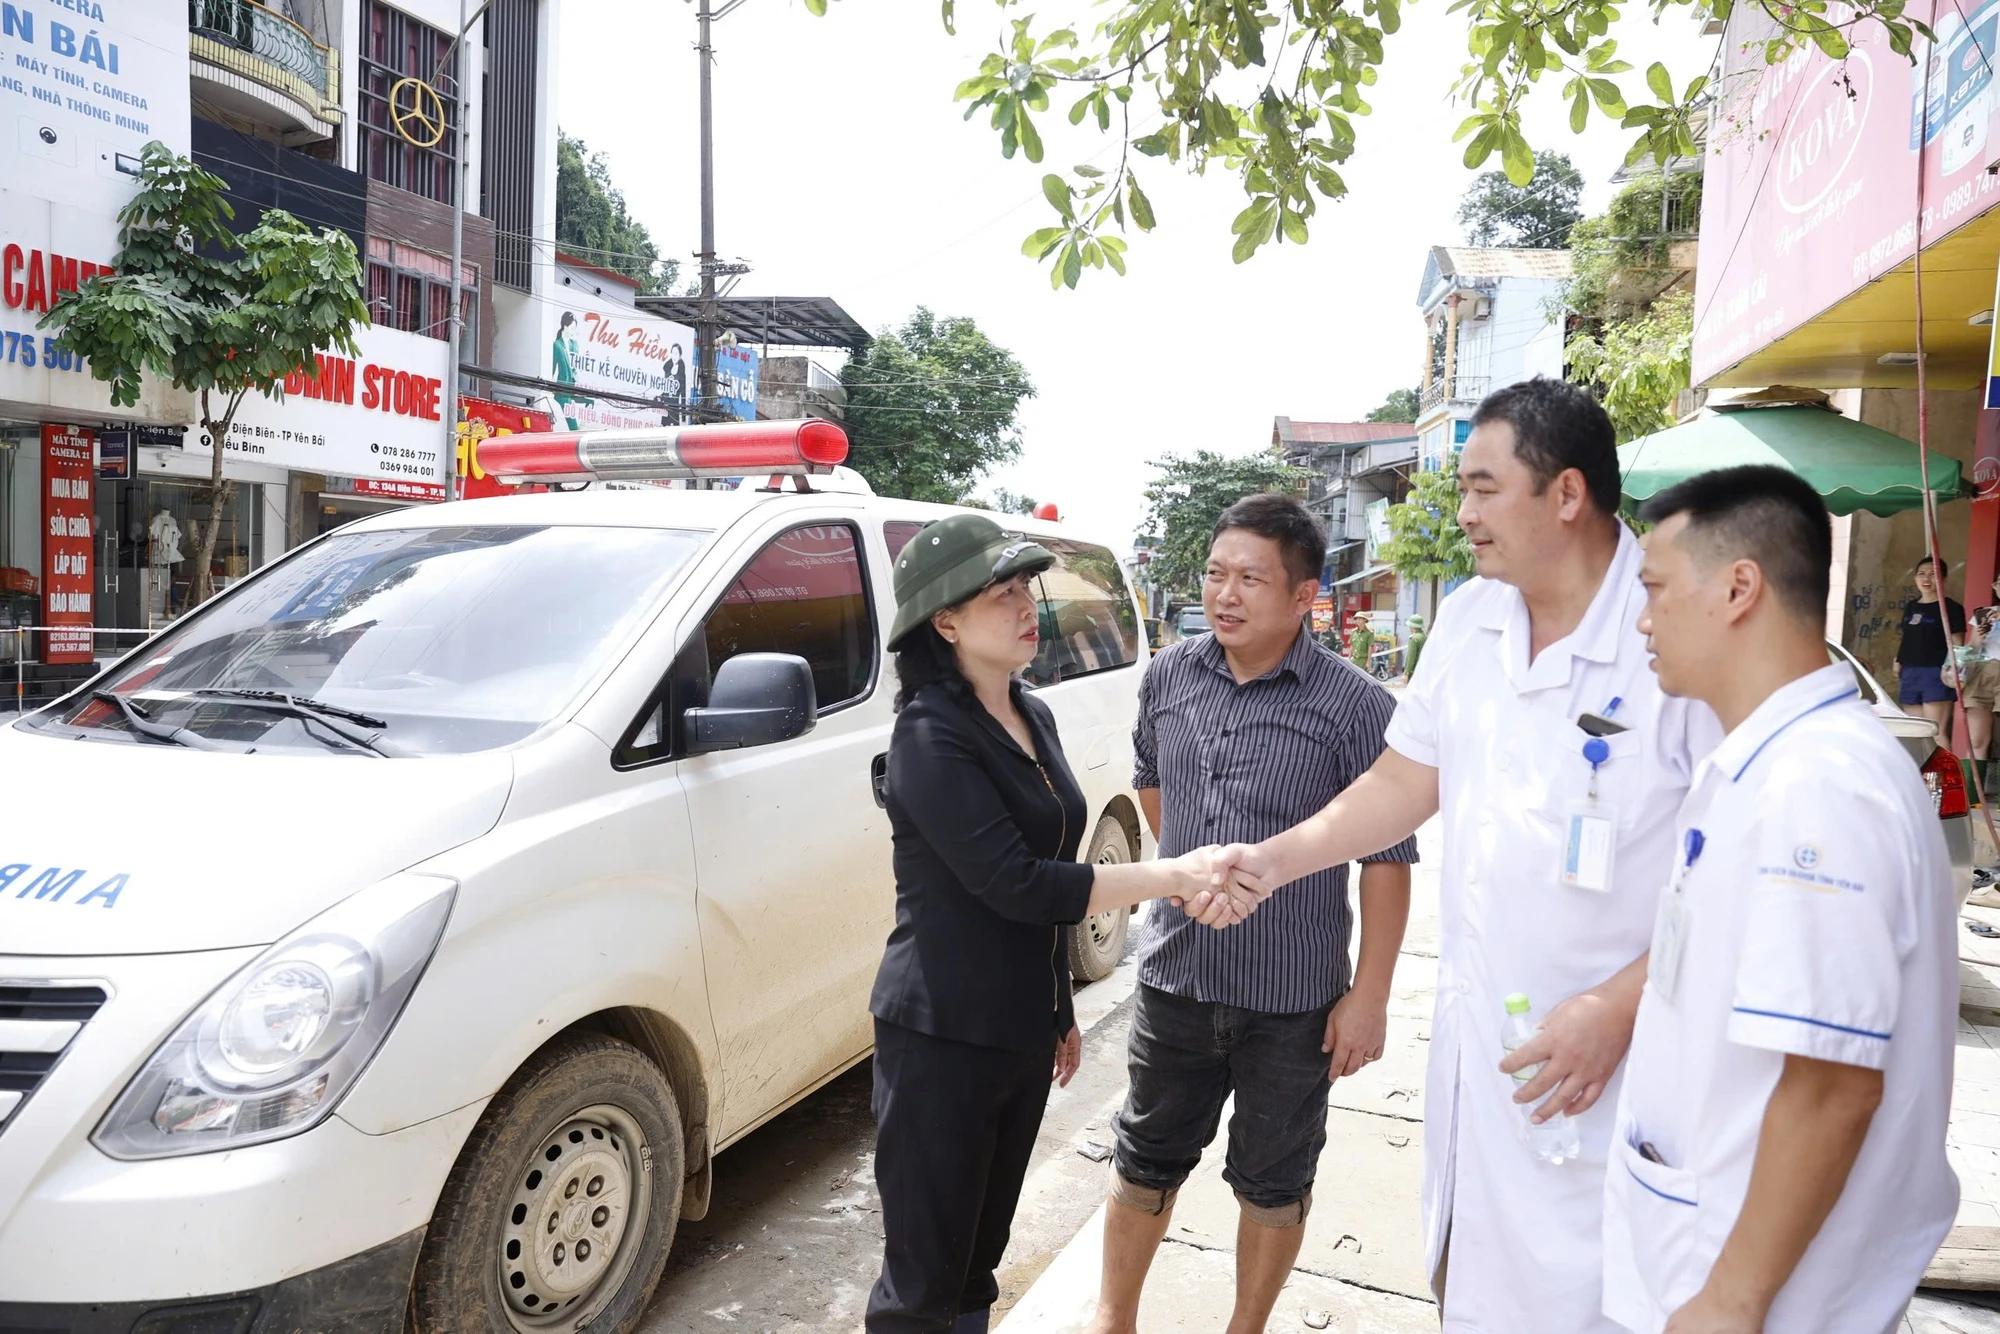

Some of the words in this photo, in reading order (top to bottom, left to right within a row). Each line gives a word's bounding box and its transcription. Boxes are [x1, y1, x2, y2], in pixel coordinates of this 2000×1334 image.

[51, 20, 118, 75] BÁI
[16, 54, 48, 75] MÁY
[53, 67, 89, 91] TÍNH,
[93, 82, 148, 110] CAMERA
[66, 97, 111, 123] THÔNG
[115, 114, 149, 135] MINH
[1788, 95, 1856, 185] KOVA
[1869, 206, 1933, 268] 0972.066.78
[3, 243, 115, 313] CAM
[0, 330, 36, 367] 75
[584, 312, 619, 348] Thu
[628, 327, 668, 362] Hiền
[569, 351, 595, 373] THIẾT
[598, 356, 611, 377] KẾ
[613, 365, 647, 385] CHUYÊN
[650, 376, 680, 397] NGHIỆP
[717, 369, 739, 399] SÀN
[362, 364, 441, 421] STORE
[52, 434, 68, 446] MÁY
[69, 435, 88, 447] TÍNH
[232, 423, 253, 438] Điện
[256, 427, 274, 439] Biên
[282, 430, 292, 441] TP
[294, 432, 309, 444] Yên
[312, 435, 325, 446] Bái
[242, 441, 265, 454] Binn
[50, 447, 80, 458] CAMERA
[382, 446, 398, 456] 078
[400, 448, 415, 459] 286
[418, 451, 436, 462] 7777
[380, 461, 401, 472] 0369
[403, 464, 418, 475] 984
[420, 466, 434, 477] 001
[1974, 469, 1997, 483] KOVA
[52, 478, 70, 498] MUA
[72, 476, 89, 499] BÁN
[50, 508, 67, 536] SỬA
[69, 513, 91, 538] CHỮA
[50, 585, 67, 612] BẢO
[69, 589, 91, 613] HÀNH
